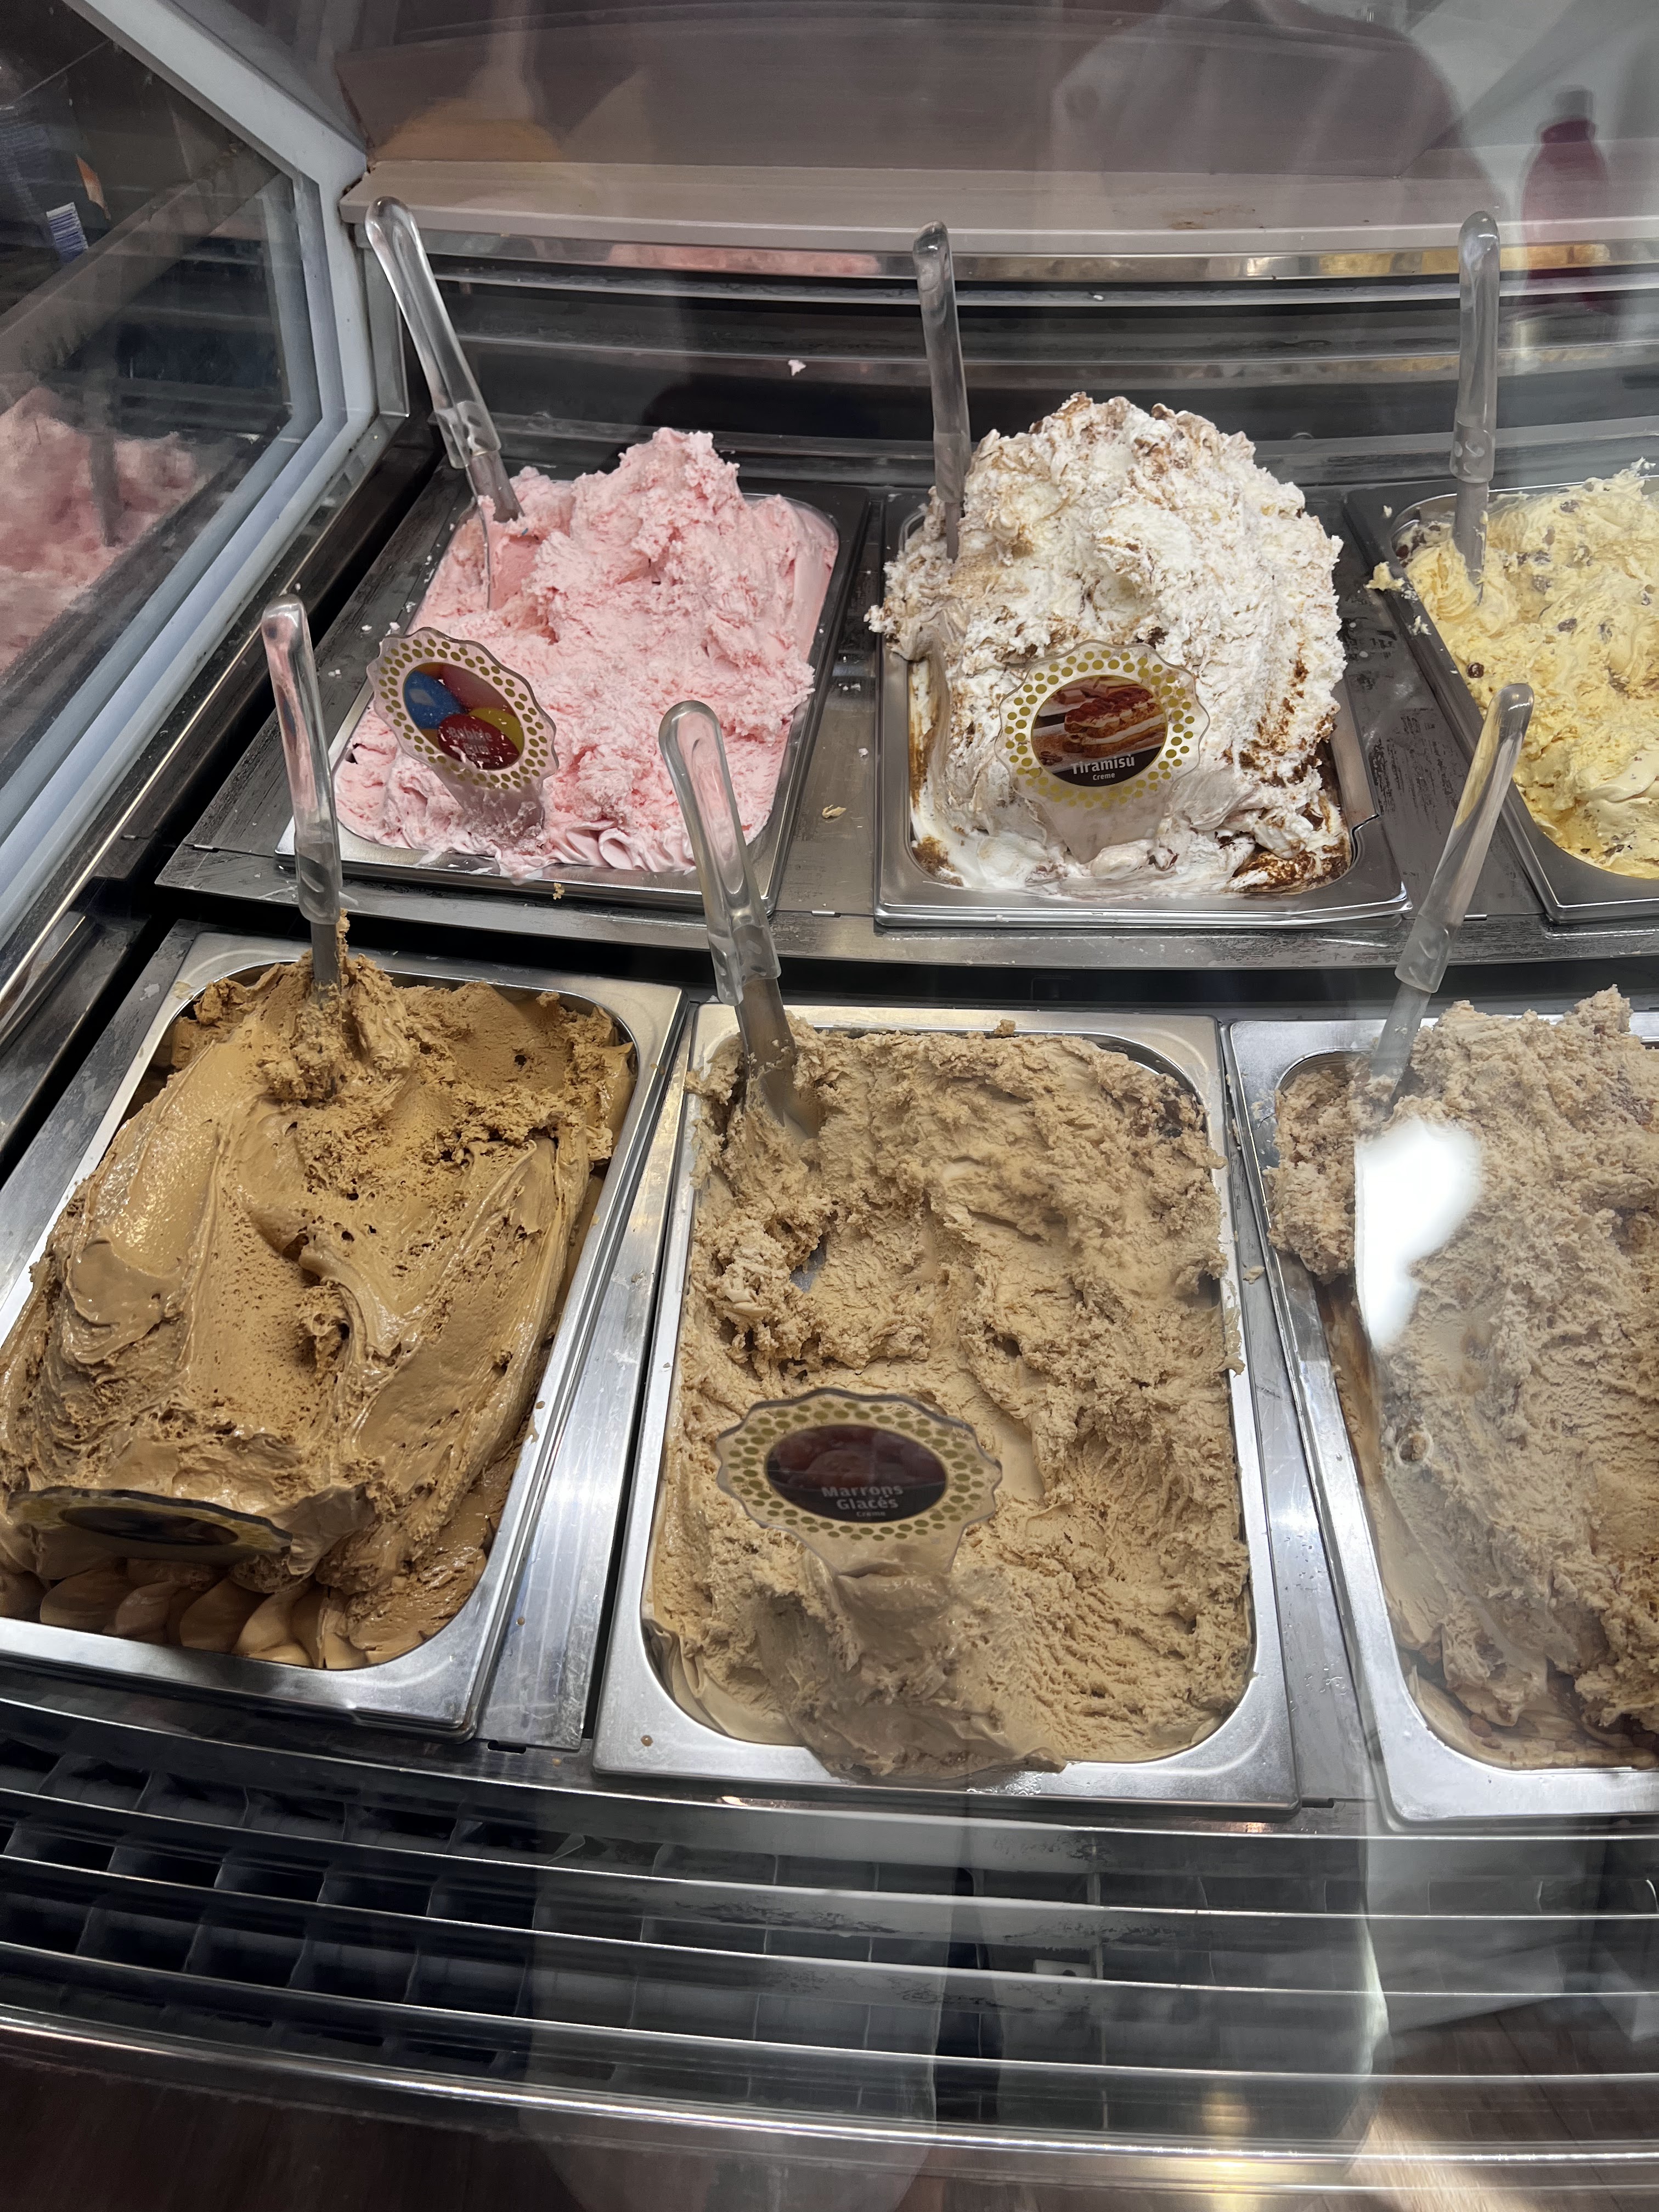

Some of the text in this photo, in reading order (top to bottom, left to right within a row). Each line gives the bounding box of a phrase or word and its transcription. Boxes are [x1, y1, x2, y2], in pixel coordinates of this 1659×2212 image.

[448, 726, 493, 742] Bubble
[1071, 754, 1135, 775] Tiramisù
[1093, 772, 1115, 781] Creme
[821, 1486, 904, 1497] Marrons
[836, 1497, 899, 1510] Glacés
